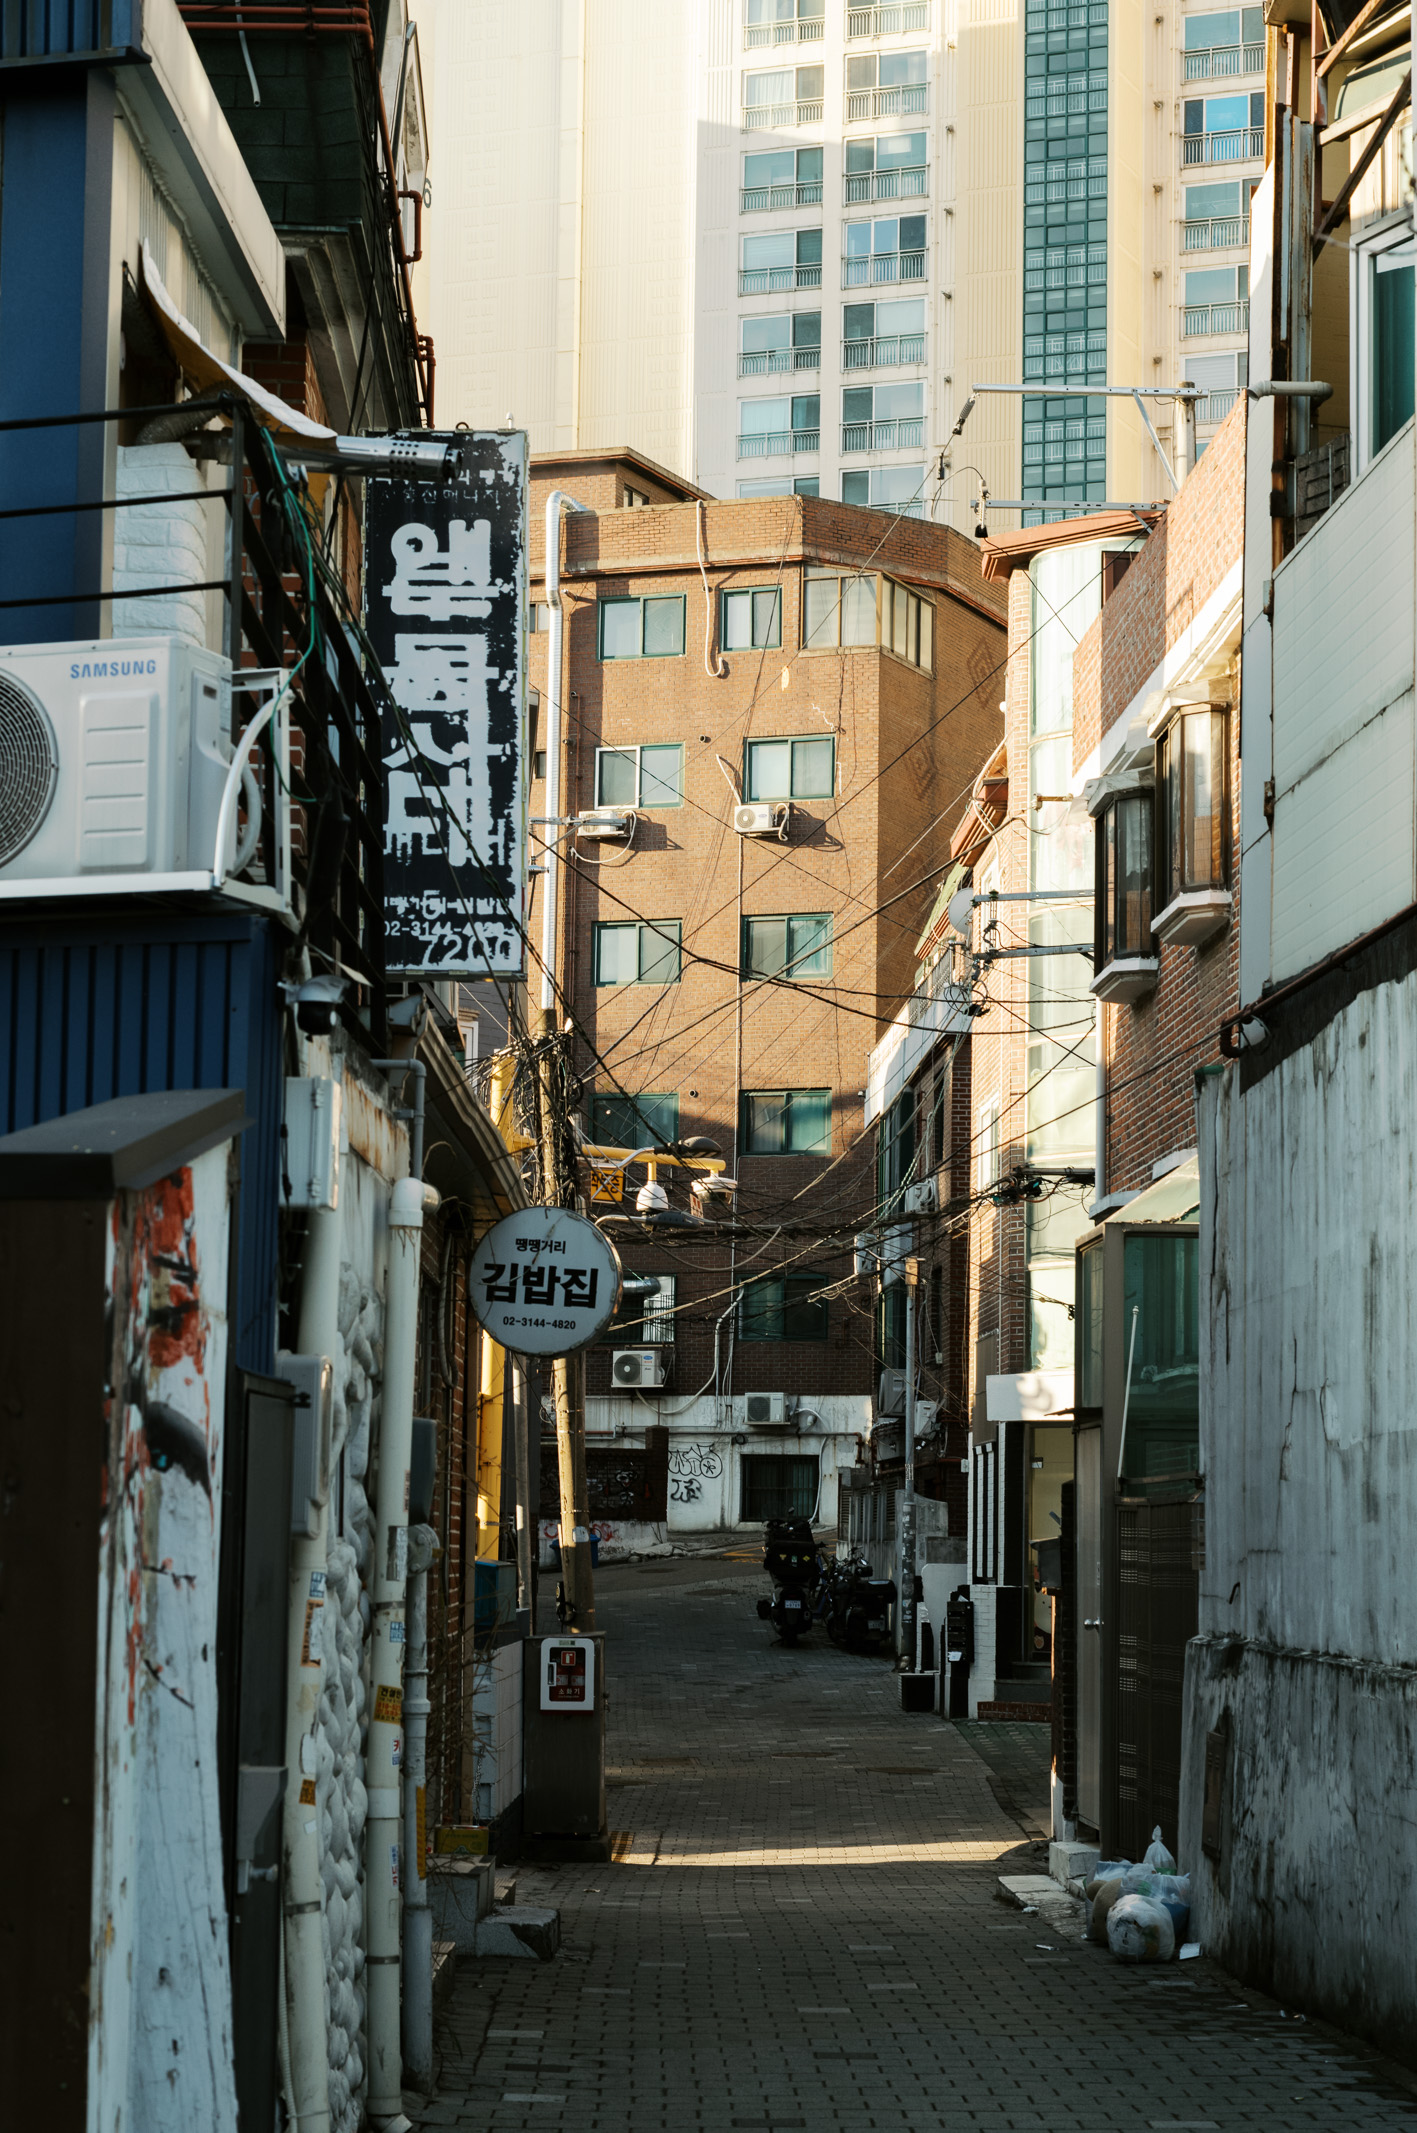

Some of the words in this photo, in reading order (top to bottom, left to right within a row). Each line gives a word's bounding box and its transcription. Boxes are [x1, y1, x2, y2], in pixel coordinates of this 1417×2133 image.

[70, 660, 156, 679] SAMSUNG
[515, 1238, 566, 1254] 땡땡거리
[481, 1263, 599, 1309] 김밥집
[503, 1316, 576, 1330] 02-3144-4820
